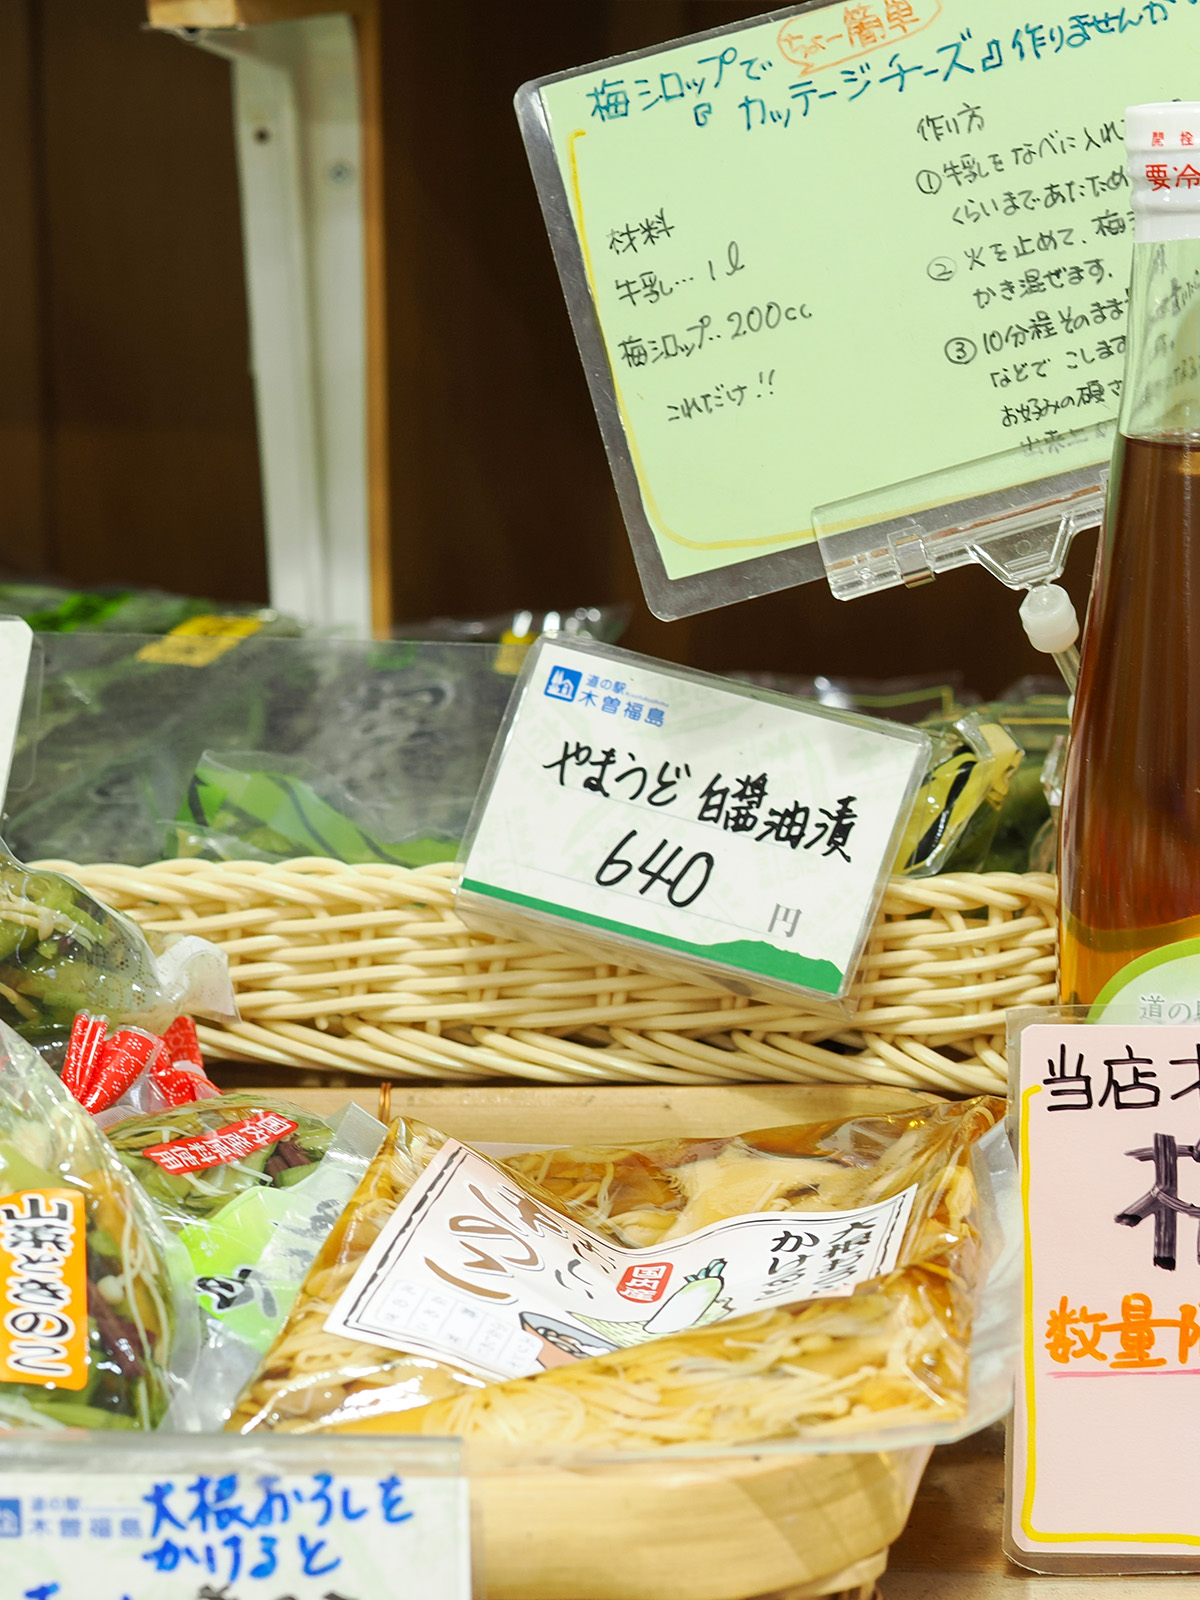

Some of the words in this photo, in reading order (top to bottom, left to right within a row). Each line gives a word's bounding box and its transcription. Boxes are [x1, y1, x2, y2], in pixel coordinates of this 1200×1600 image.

[586, 47, 772, 122] 梅シロップで
[916, 102, 985, 142] 作り方
[606, 207, 676, 255] 材料
[586, 673, 627, 696] 道の駅
[577, 690, 665, 728] 木曽福島
[542, 740, 690, 807] やまうど
[594, 829, 715, 908] 640
[767, 903, 802, 938] 円
[619, 1264, 665, 1302] 国内産
[141, 1532, 342, 1583] かけると
